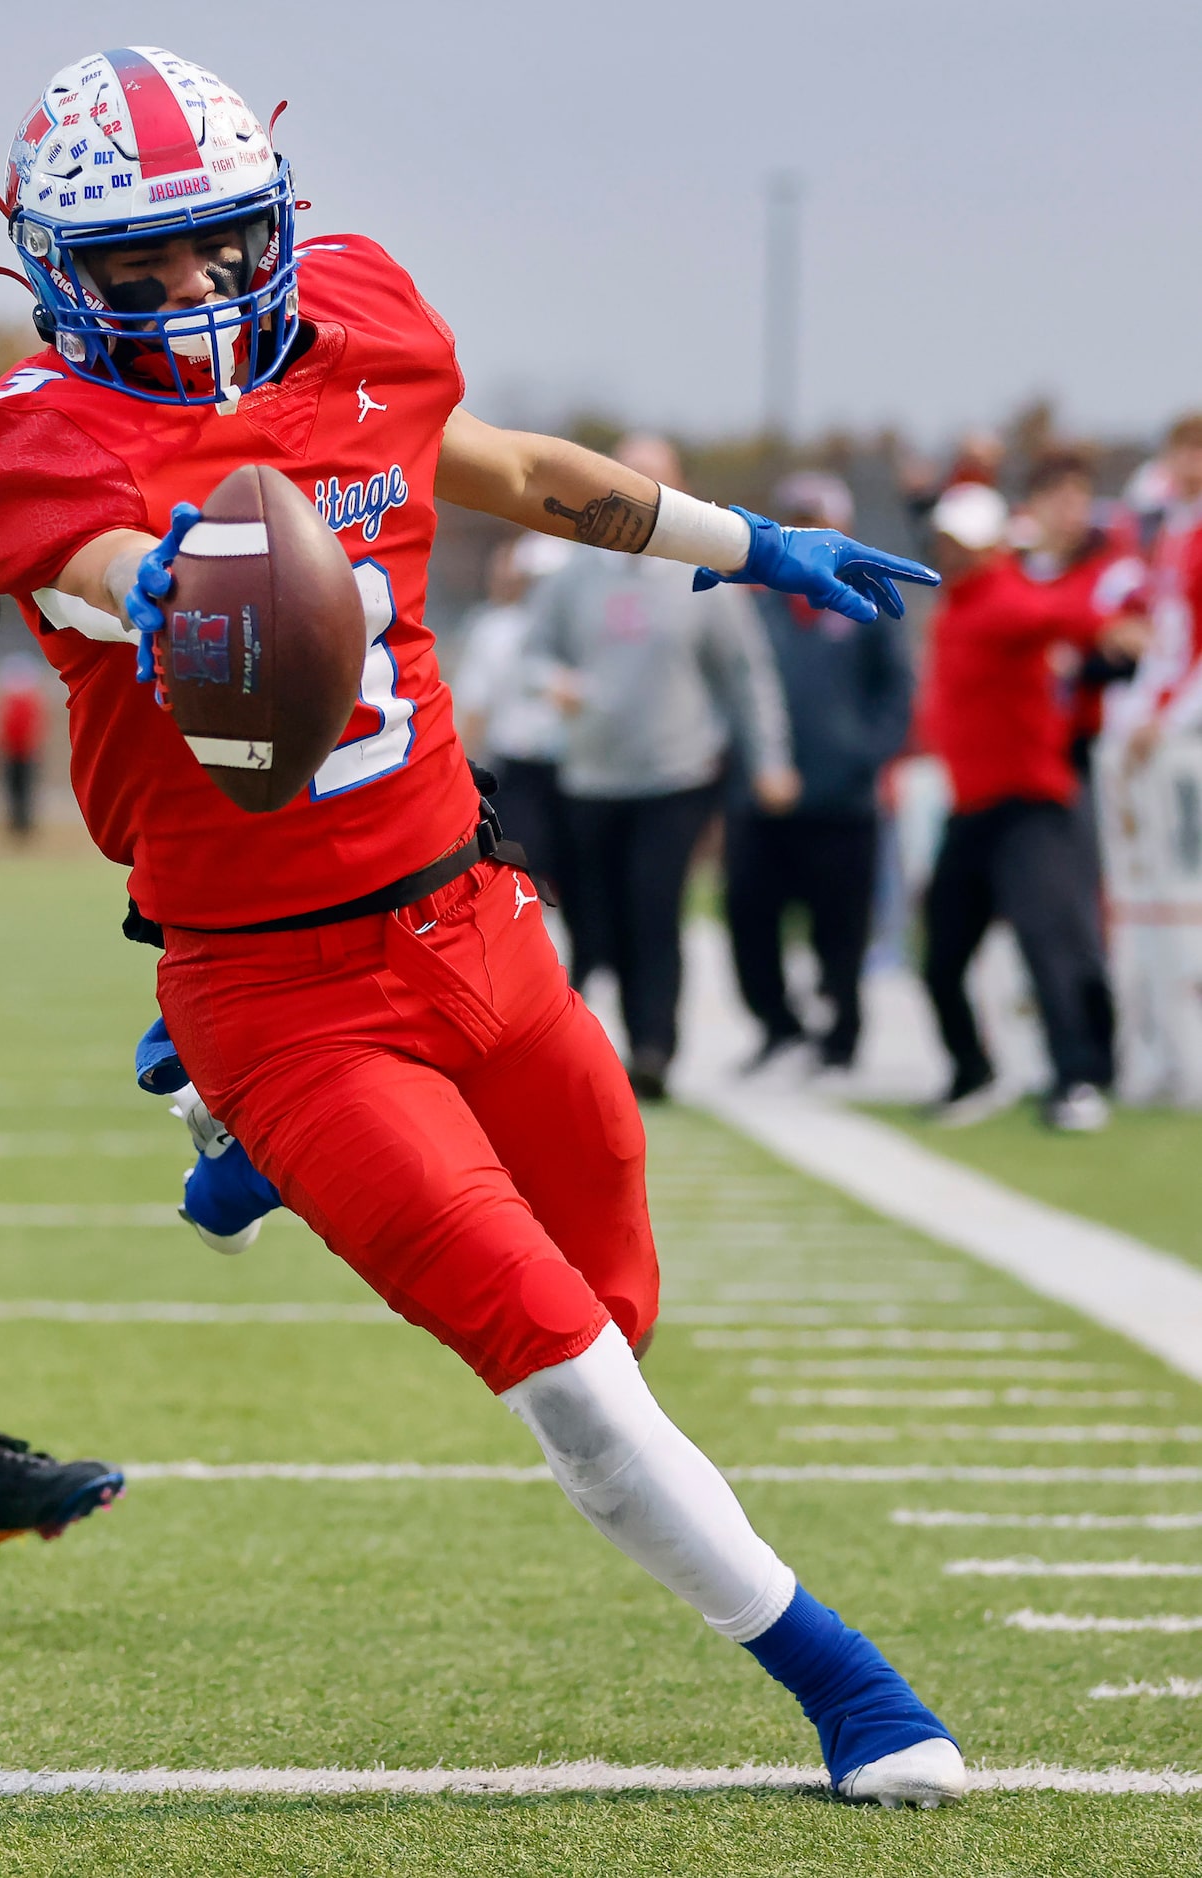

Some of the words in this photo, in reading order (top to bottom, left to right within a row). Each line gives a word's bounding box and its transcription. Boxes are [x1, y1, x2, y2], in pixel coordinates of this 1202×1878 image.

[81, 70, 102, 86] FEAST
[58, 92, 79, 107] FEAST
[89, 102, 108, 118] 22
[62, 113, 80, 127] 22
[102, 120, 123, 137] 22
[70, 139, 88, 160] DLT
[94, 151, 115, 165] DLT
[211, 157, 236, 173] FIGHT
[111, 173, 133, 188] DLT
[84, 185, 104, 200] DLT
[148, 175, 211, 204] JAGUARS
[59, 191, 77, 208] DLT
[315, 464, 408, 542] itage
